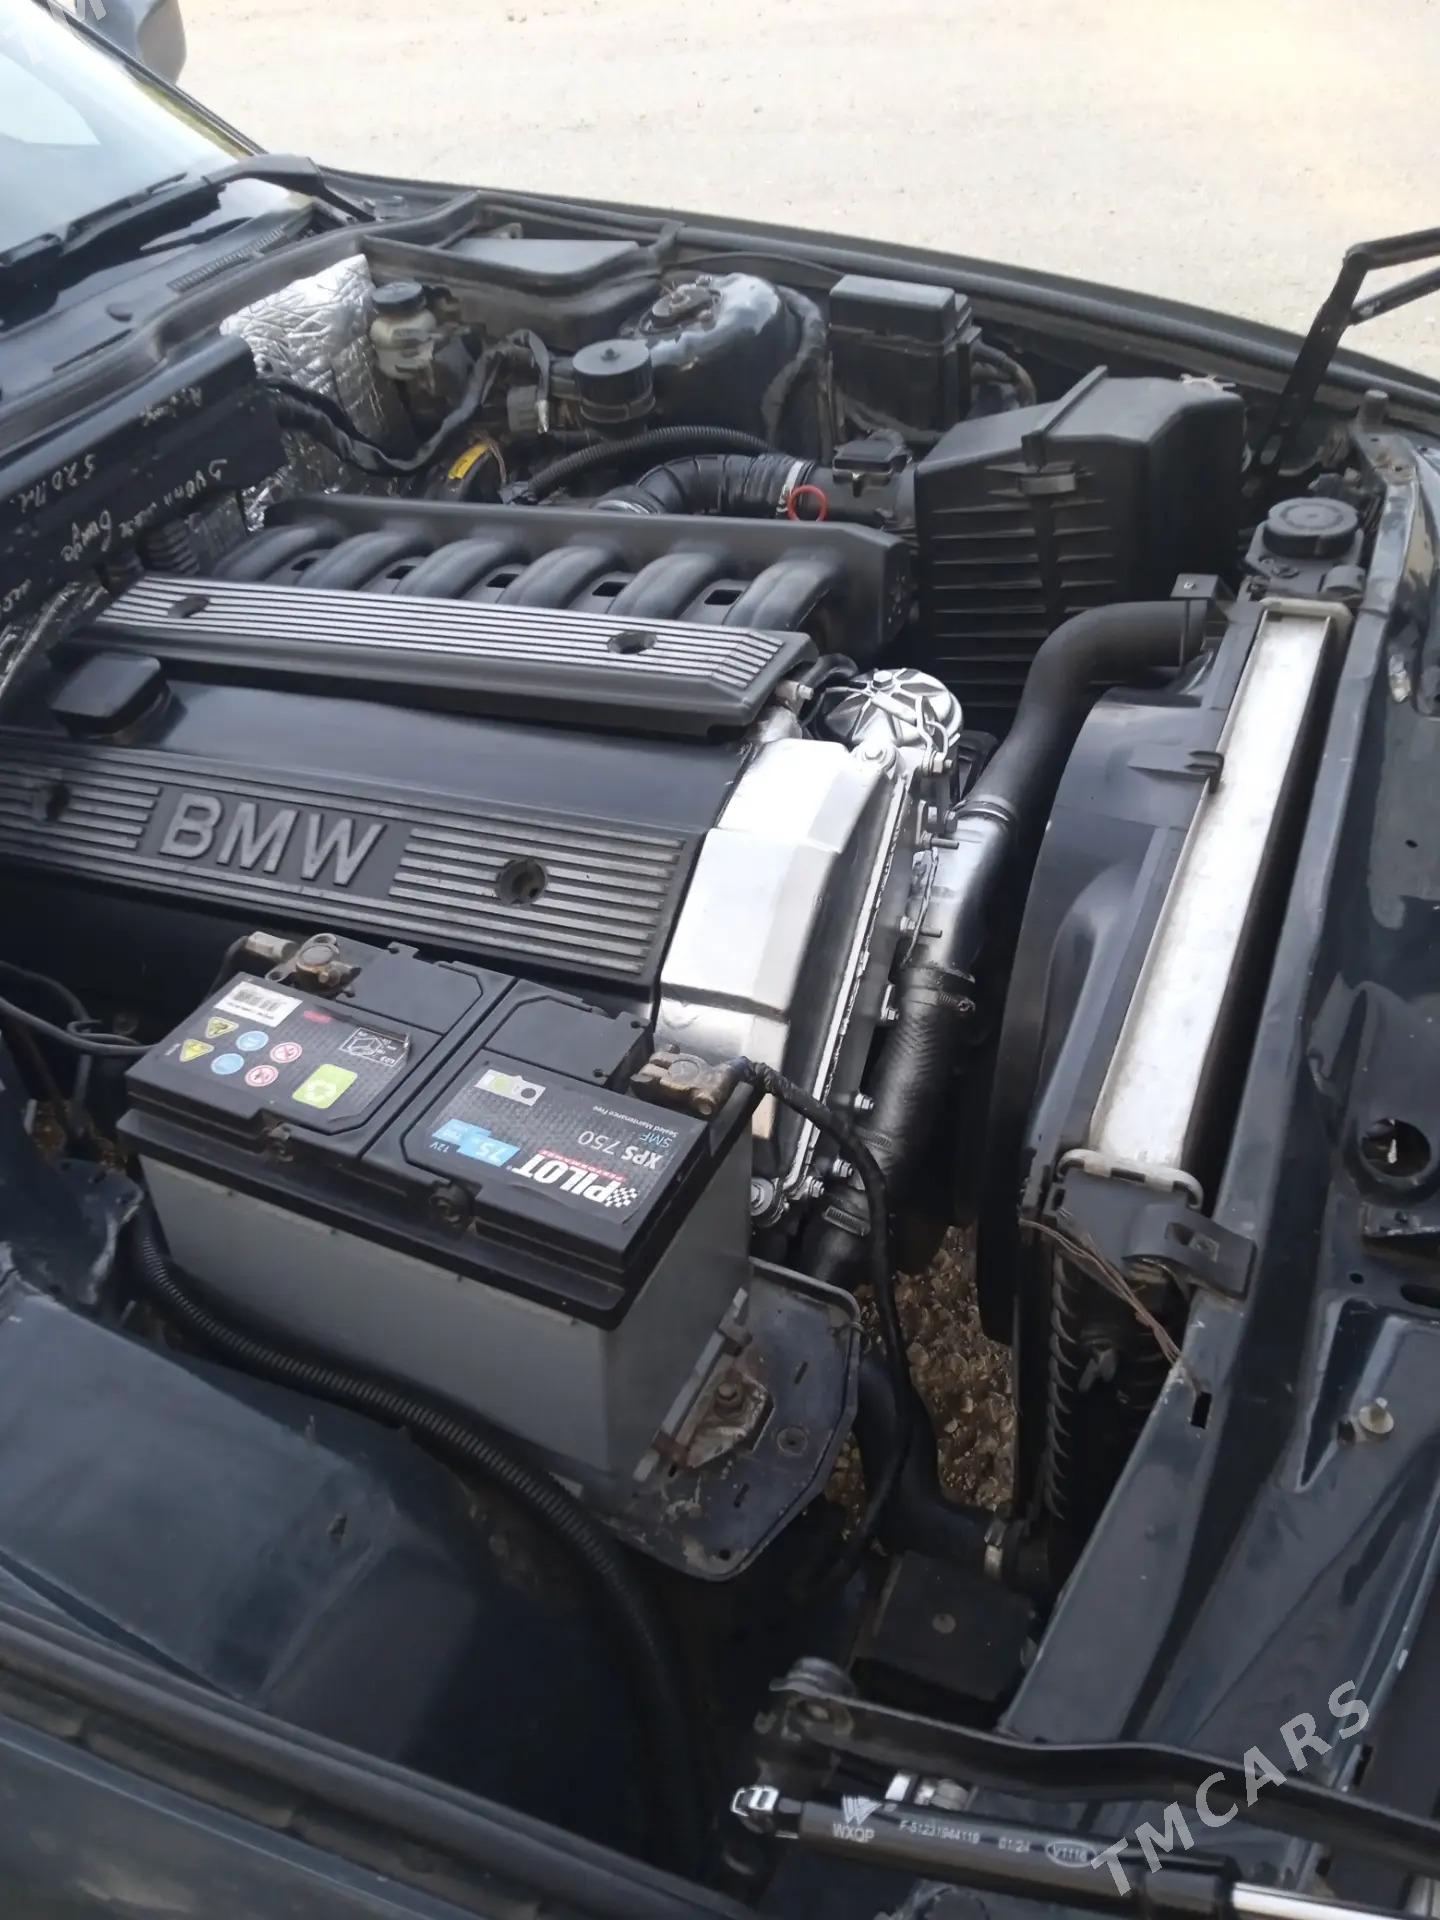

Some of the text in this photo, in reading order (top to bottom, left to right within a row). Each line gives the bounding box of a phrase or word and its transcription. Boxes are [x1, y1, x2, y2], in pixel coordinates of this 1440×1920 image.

[159, 793, 387, 887] BMW
[608, 1110, 654, 1131] Maintenance
[654, 1124, 680, 1138] Sealed
[430, 1141, 450, 1153] 12V
[578, 1130, 663, 1169] XPS 750
[639, 1131, 673, 1149] SMF
[512, 1154, 620, 1202] PILOT
